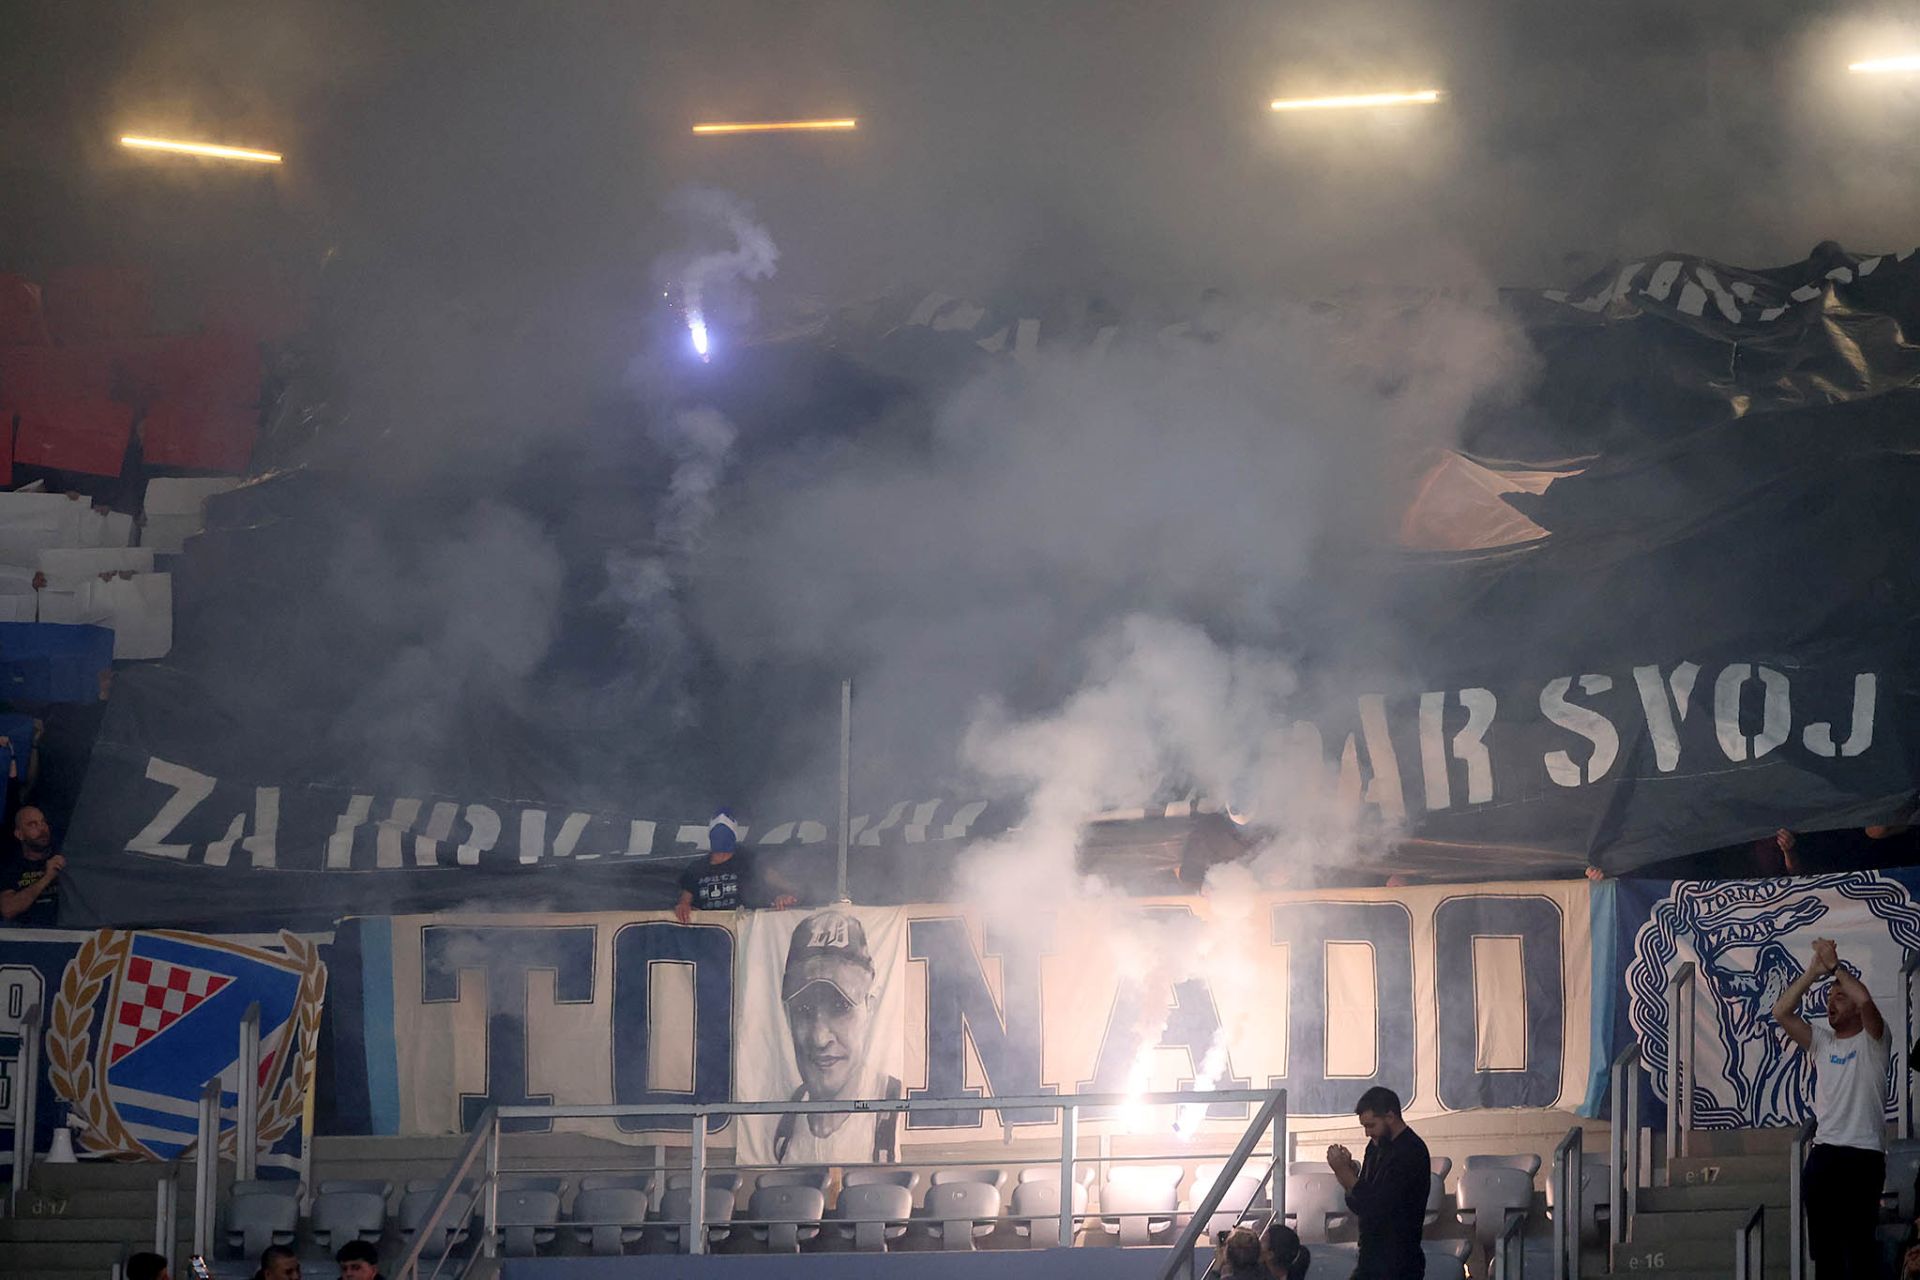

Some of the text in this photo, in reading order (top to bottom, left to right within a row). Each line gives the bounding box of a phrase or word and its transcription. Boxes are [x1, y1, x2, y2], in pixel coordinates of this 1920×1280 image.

[1538, 659, 1877, 788] SVOJ
[1701, 877, 1793, 916] TORNADO
[1709, 918, 1775, 946] ZADAR
[420, 894, 1566, 1134] TONADO
